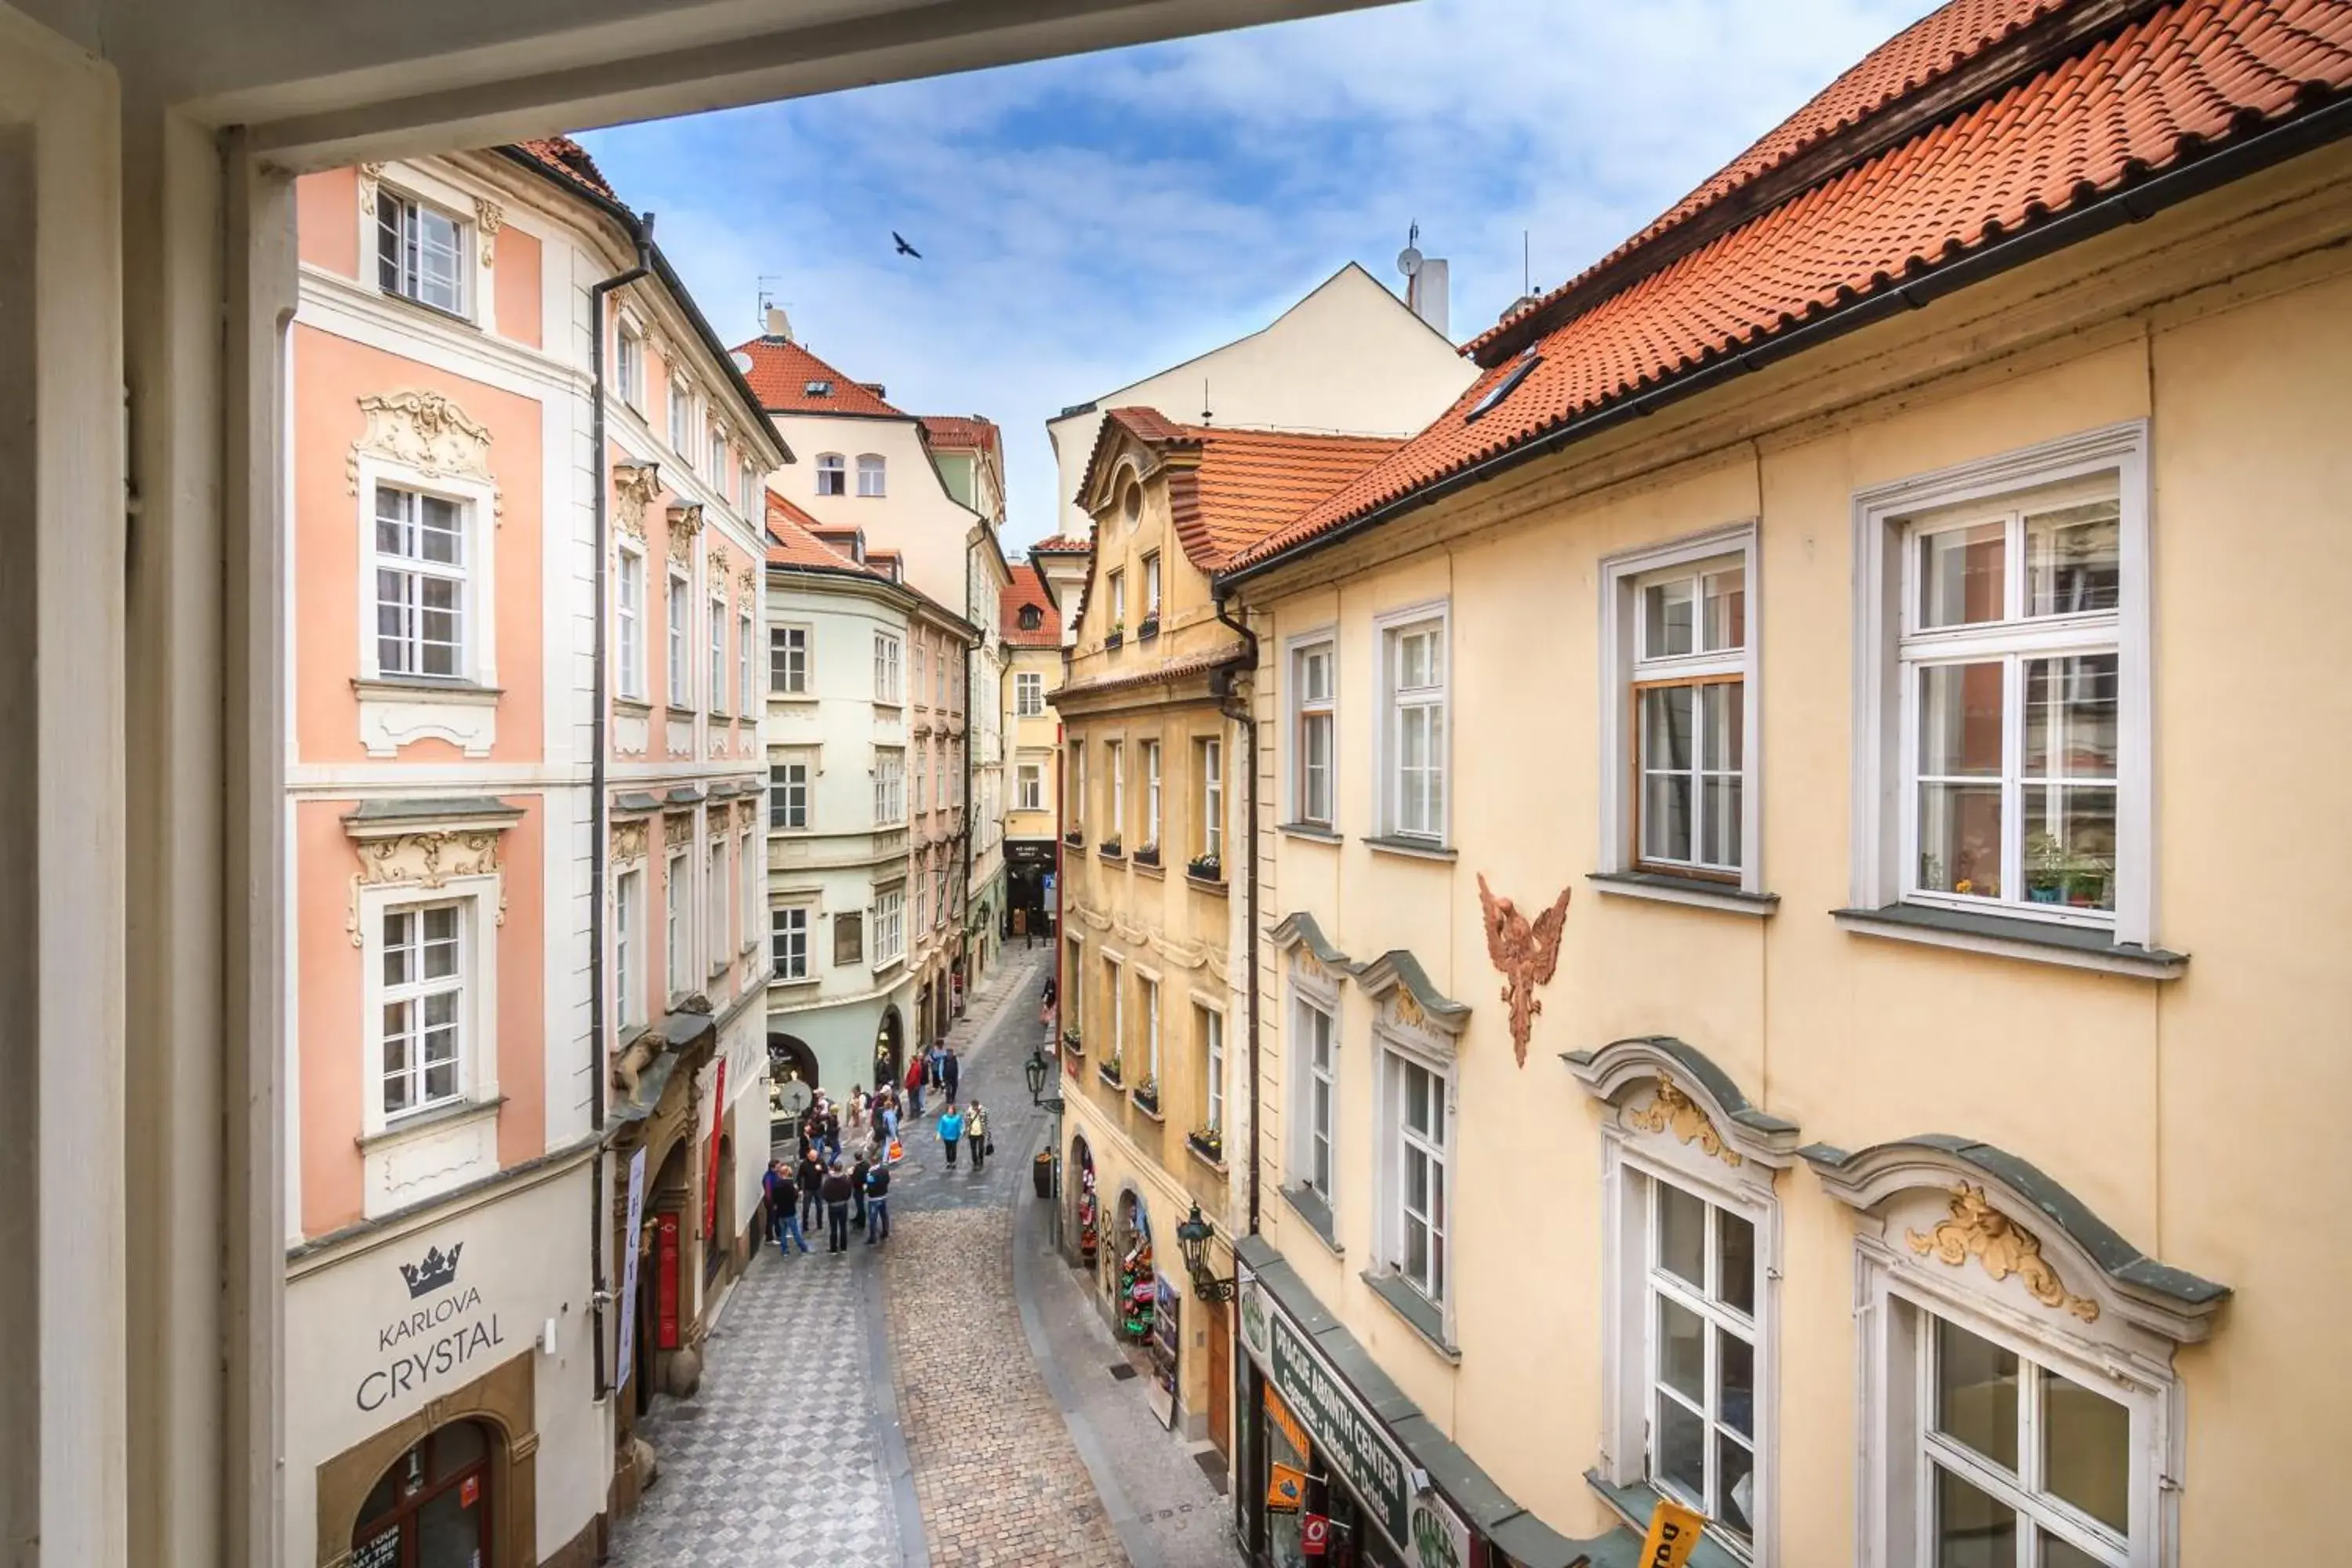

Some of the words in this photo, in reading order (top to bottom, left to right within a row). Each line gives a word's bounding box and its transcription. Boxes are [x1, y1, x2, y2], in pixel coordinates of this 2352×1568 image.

[357, 1312, 504, 1411] CRYSTAL
[379, 1287, 481, 1352] KARLOVA
[1276, 1322, 1311, 1390] PRAGUE
[1312, 1367, 1352, 1442] ABSINTH
[1354, 1421, 1399, 1501] CENTER
[1323, 1420, 1354, 1479] Alcohol
[1360, 1465, 1390, 1525] Drinks
